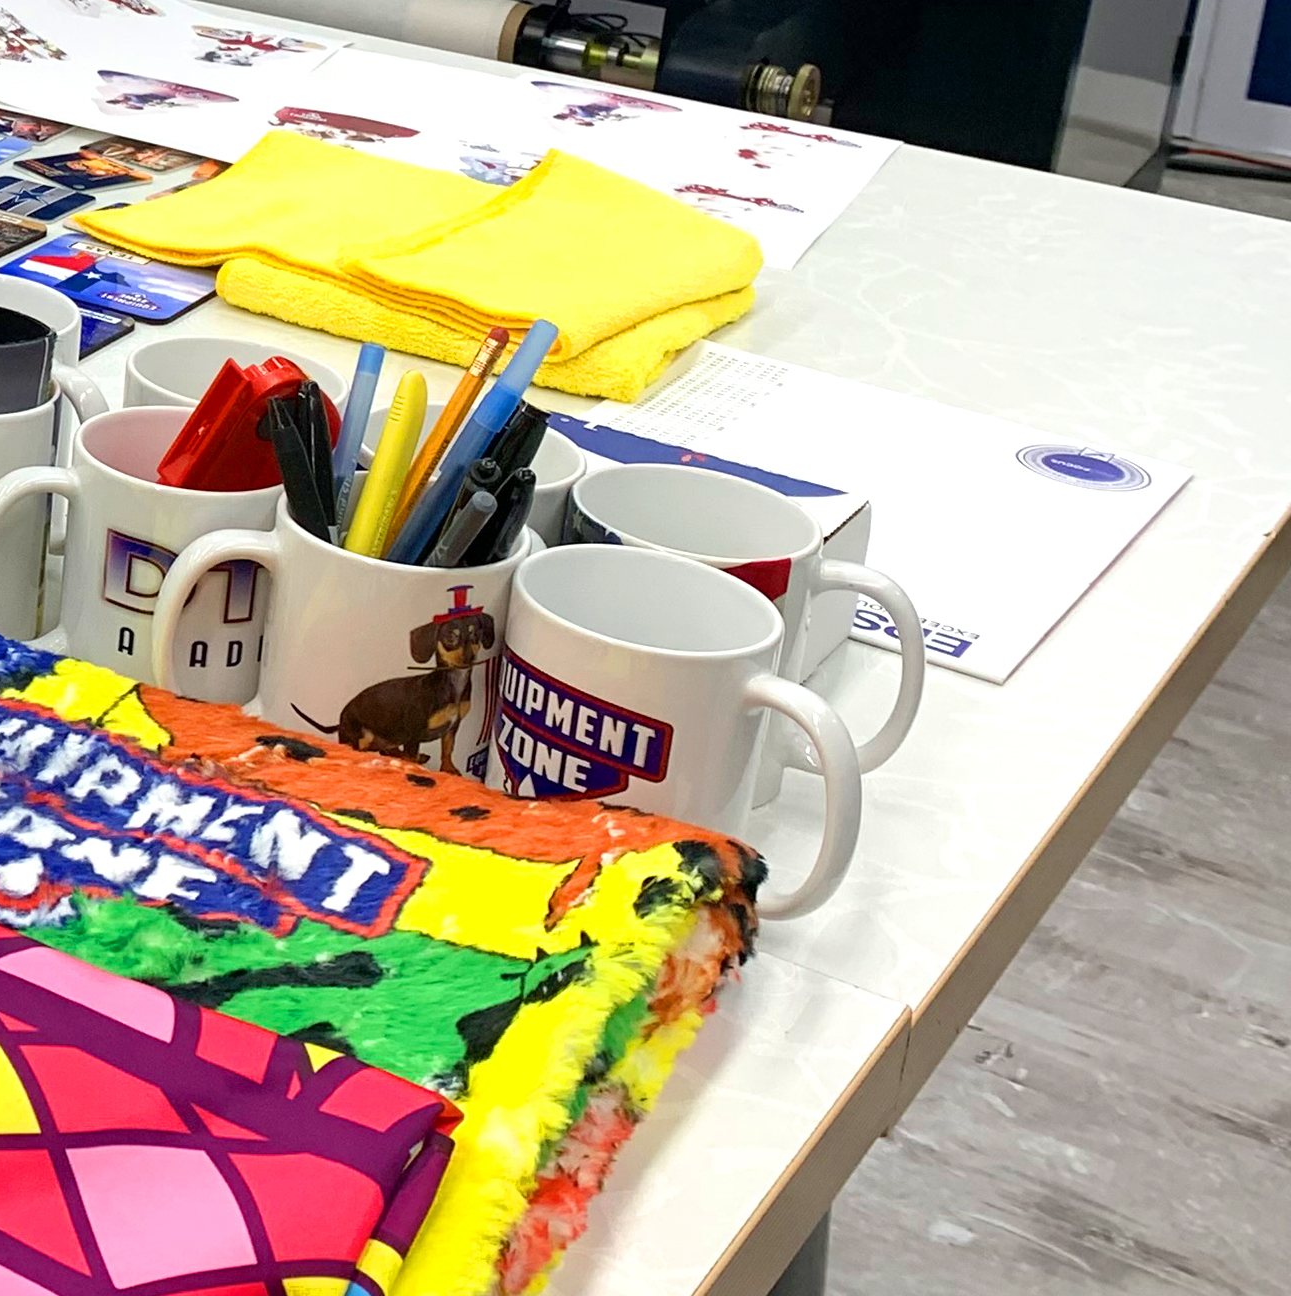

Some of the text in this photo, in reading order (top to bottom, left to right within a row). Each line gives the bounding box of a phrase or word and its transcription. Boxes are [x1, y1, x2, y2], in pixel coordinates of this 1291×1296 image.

[85, 244, 135, 260] TEXAS
[101, 291, 159, 312] EQUIPMENT
[1050, 457, 1092, 473] FOCUS
[498, 713, 593, 794] ZONE
